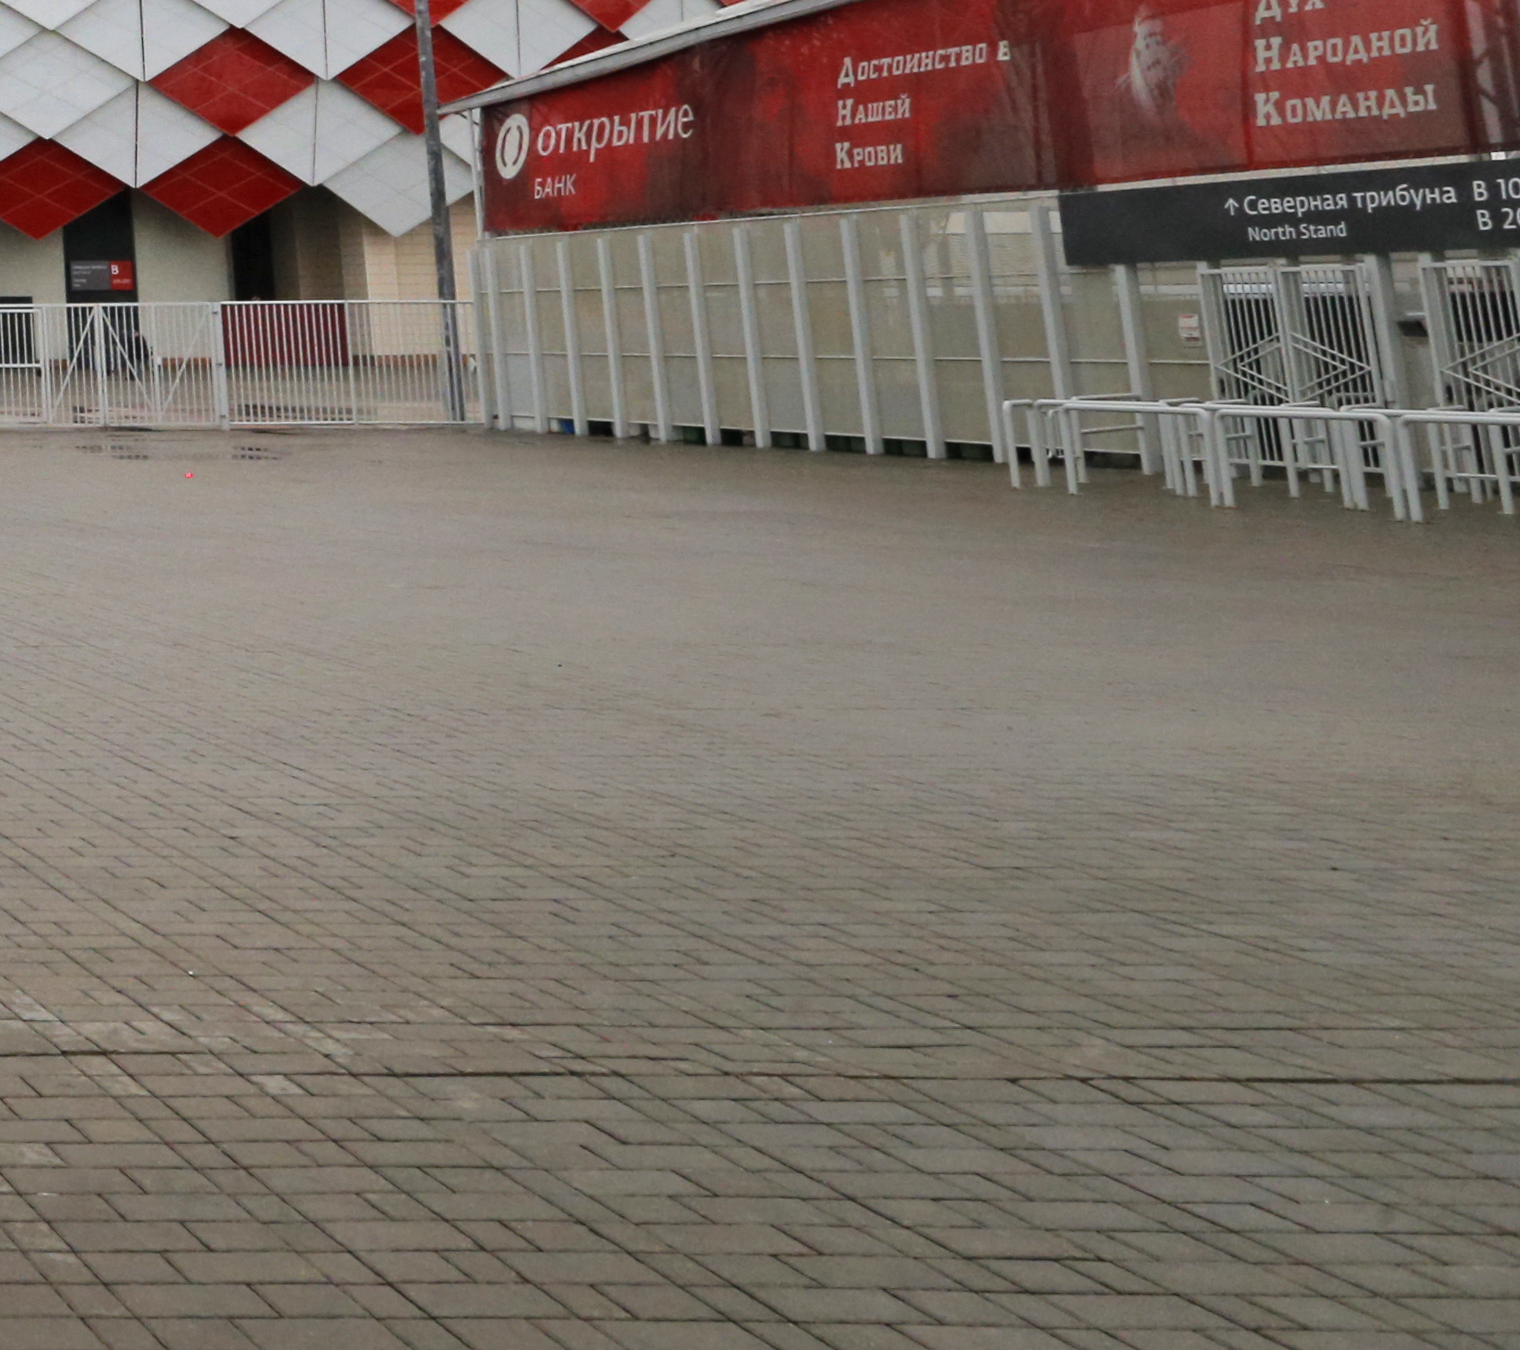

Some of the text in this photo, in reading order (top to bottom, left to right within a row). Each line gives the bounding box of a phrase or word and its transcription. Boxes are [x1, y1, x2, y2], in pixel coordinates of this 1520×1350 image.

[1254, 18, 1439, 72] НАРОДНОЙ
[837, 43, 988, 89] ДОСТОИНСТВО
[836, 93, 911, 127] НАШЕЙ
[1254, 84, 1438, 127] КОМАНДЫ
[537, 104, 694, 163] открытие
[835, 141, 904, 169] КРОВИ
[534, 174, 576, 200] БАНК
[1243, 190, 1348, 217] Северная
[1352, 184, 1457, 212] трибуна
[1248, 221, 1347, 241] North Stand
[1501, 207, 1520, 229] 2
